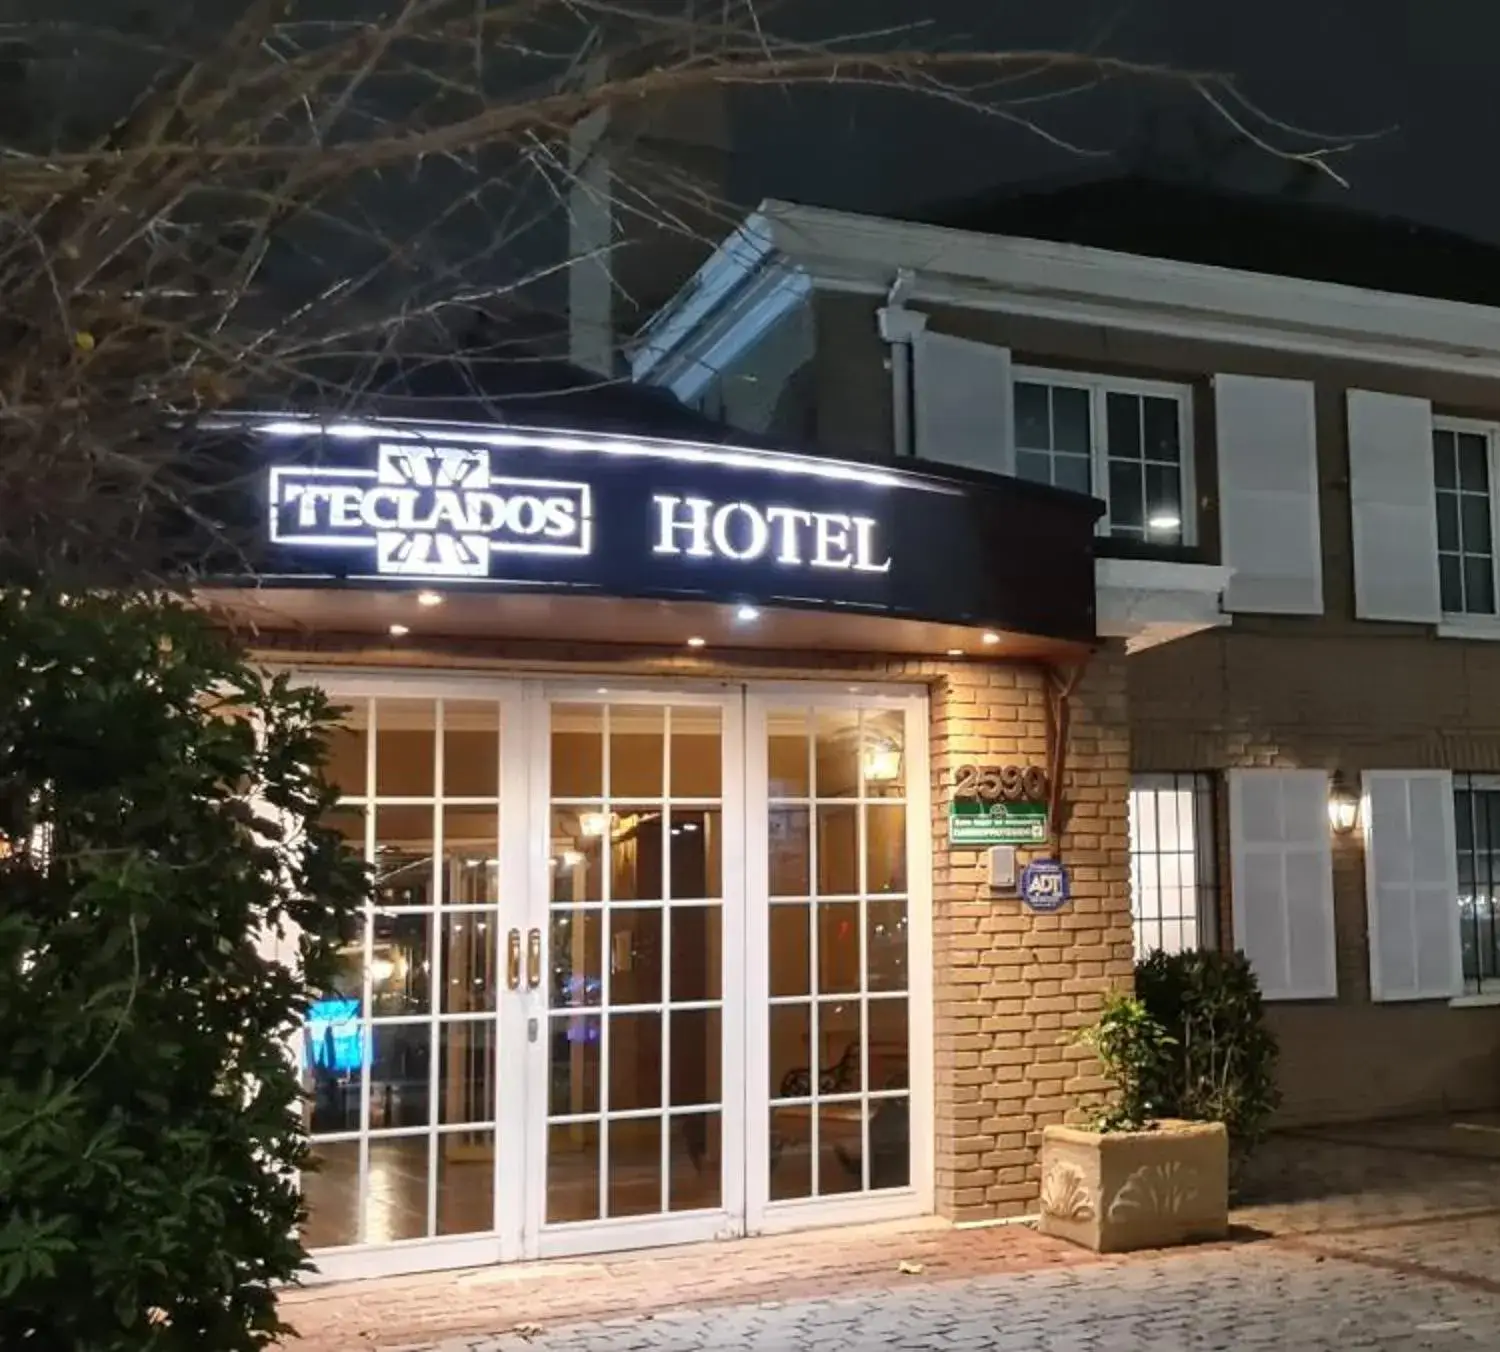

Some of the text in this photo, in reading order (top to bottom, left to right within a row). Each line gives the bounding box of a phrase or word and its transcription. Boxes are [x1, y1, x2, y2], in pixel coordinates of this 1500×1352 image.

[284, 484, 575, 537] TECLADOS
[653, 495, 892, 572] HOTEL
[954, 764, 1046, 799] 2590
[1028, 874, 1062, 897] ADT
